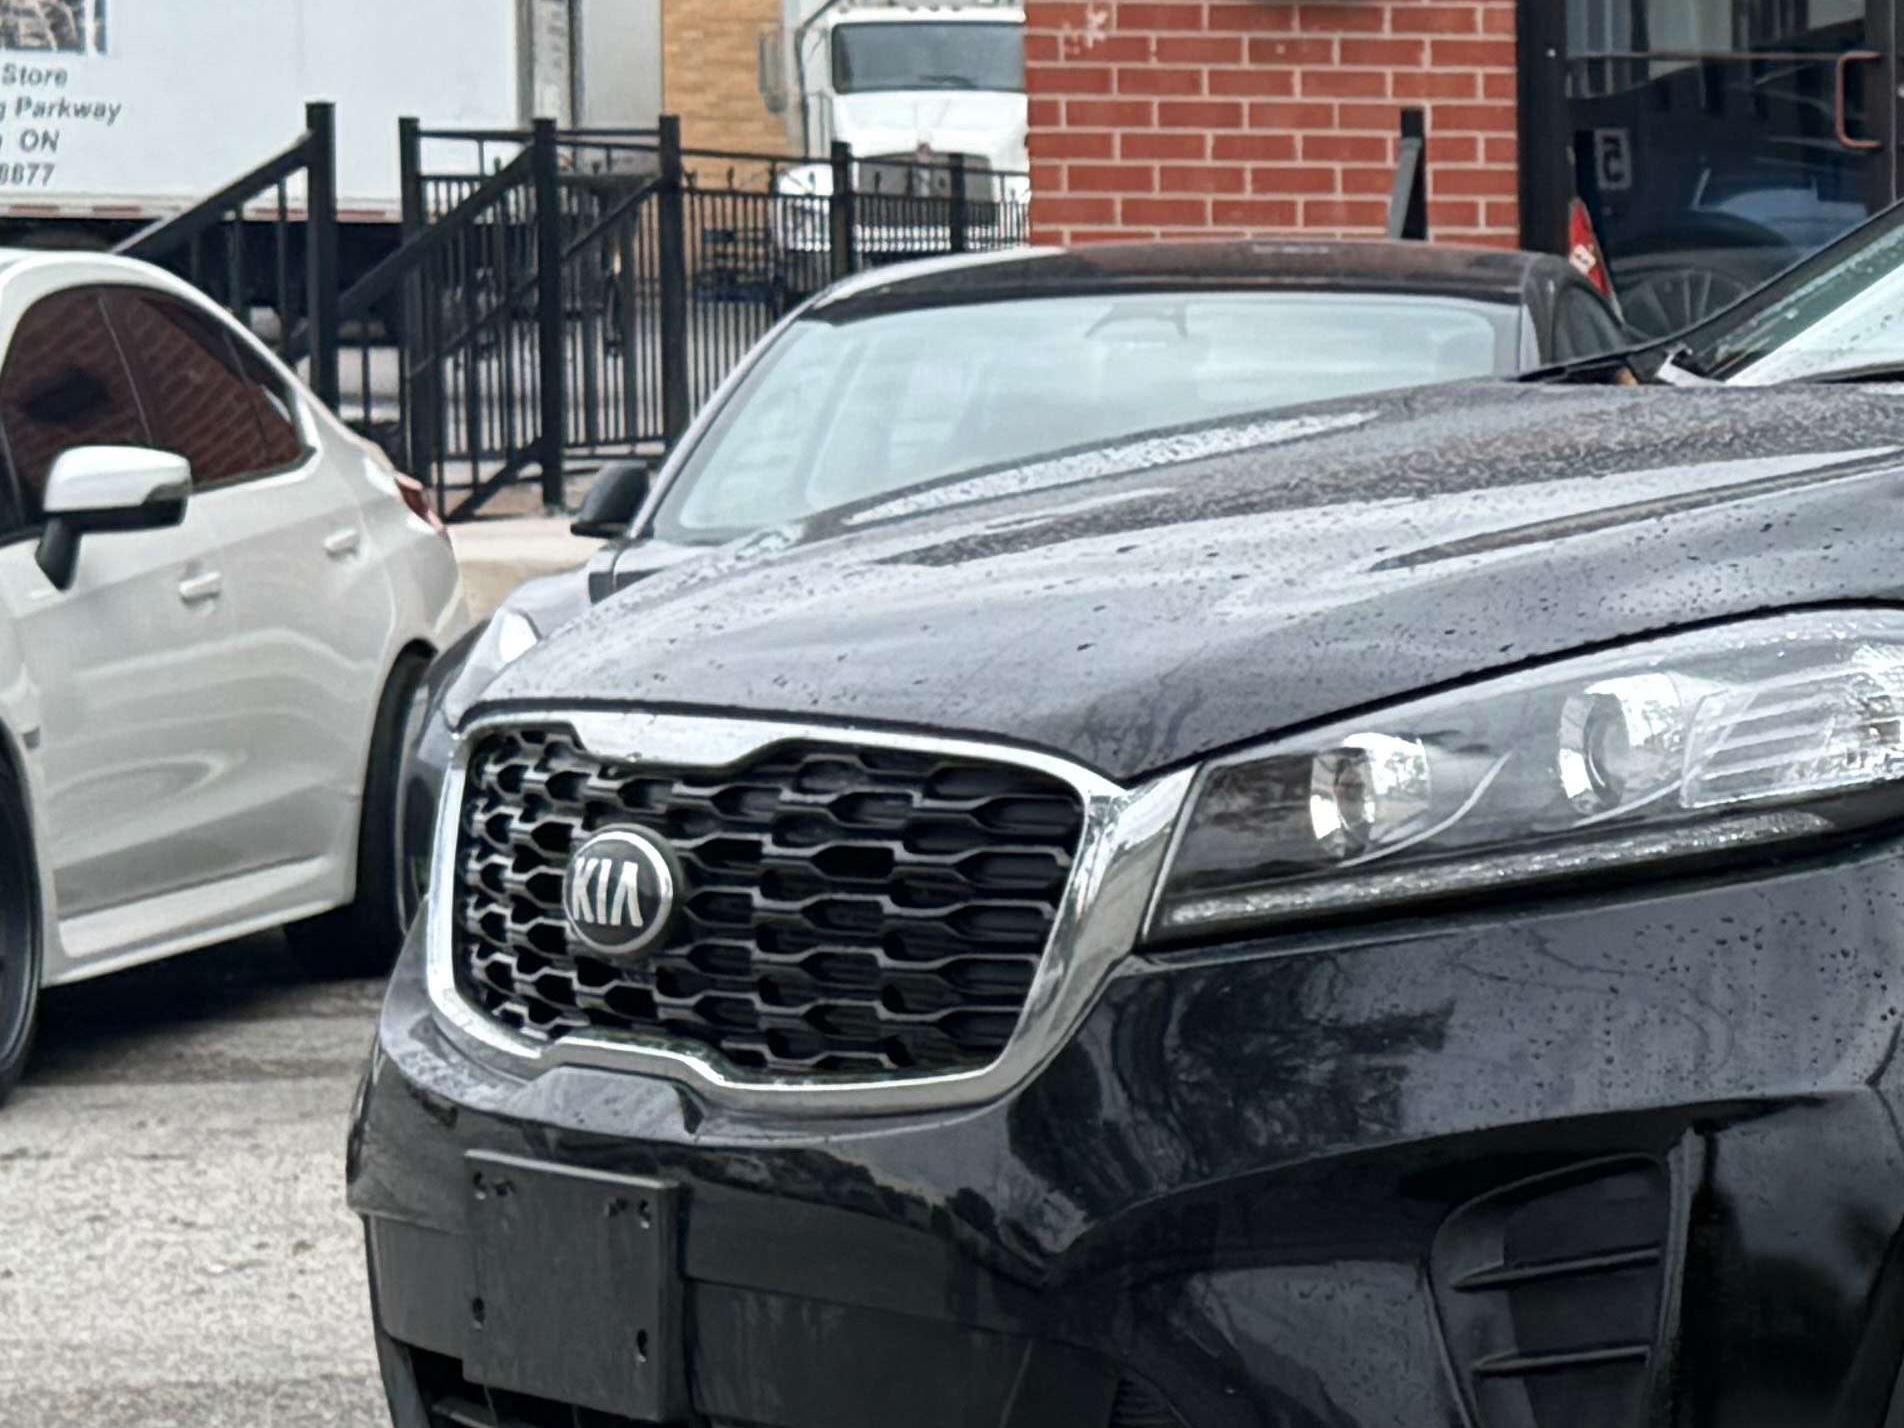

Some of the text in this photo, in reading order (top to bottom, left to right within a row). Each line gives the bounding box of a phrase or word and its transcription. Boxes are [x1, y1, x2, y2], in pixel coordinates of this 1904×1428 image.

[2, 62, 68, 87] Store
[15, 96, 122, 126] Parkway
[20, 128, 60, 153] ON
[571, 856, 644, 928] KIA
